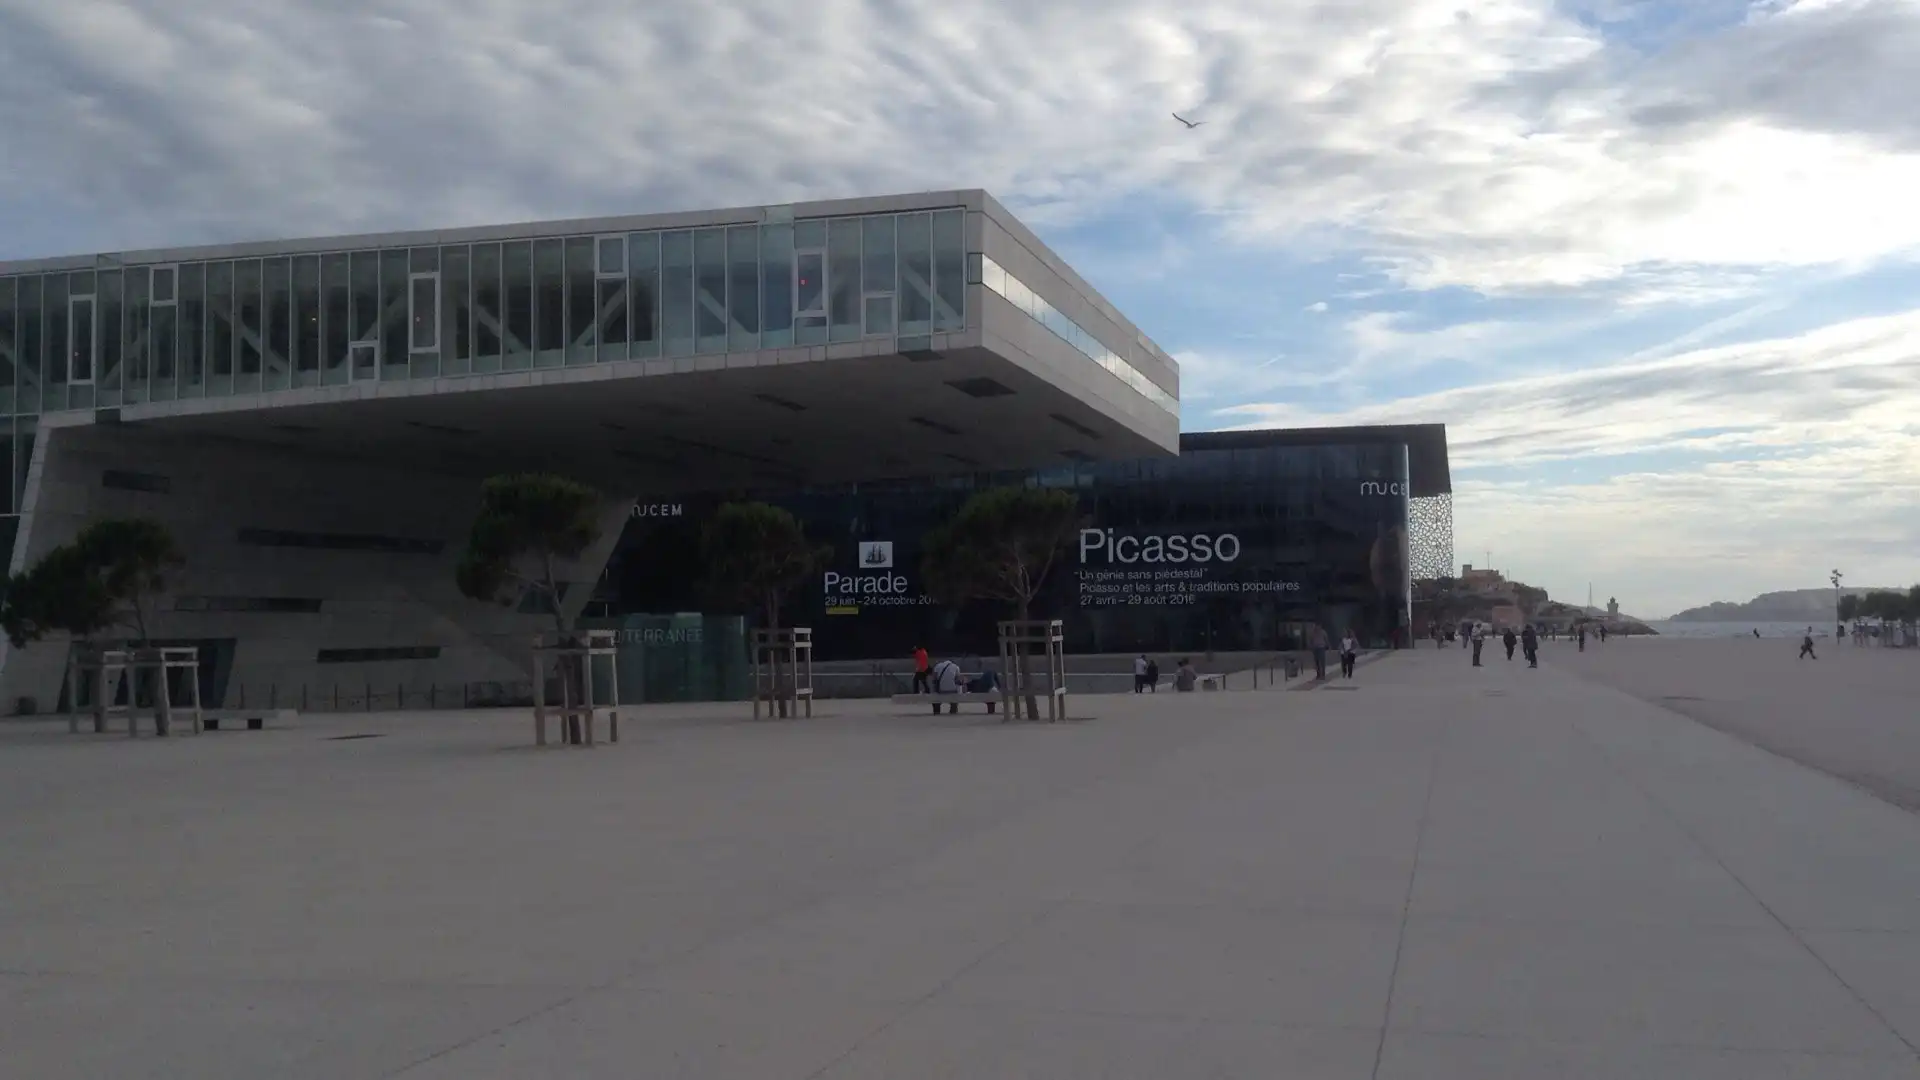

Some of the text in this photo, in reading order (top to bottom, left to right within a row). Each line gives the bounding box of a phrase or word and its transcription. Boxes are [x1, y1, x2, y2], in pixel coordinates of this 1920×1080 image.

[1079, 527, 1241, 564] Picasso
[824, 571, 908, 594] Parade
[1096, 568, 1125, 583] génie
[1127, 571, 1152, 581] sans
[1079, 579, 1301, 593] Picasso et les arts & traditions populaires
[824, 595, 837, 606] 29
[839, 595, 856, 607] juin
[863, 595, 877, 606] 24
[878, 595, 917, 606] octobre
[1080, 594, 1093, 605] 27
[1127, 594, 1142, 605] 29
